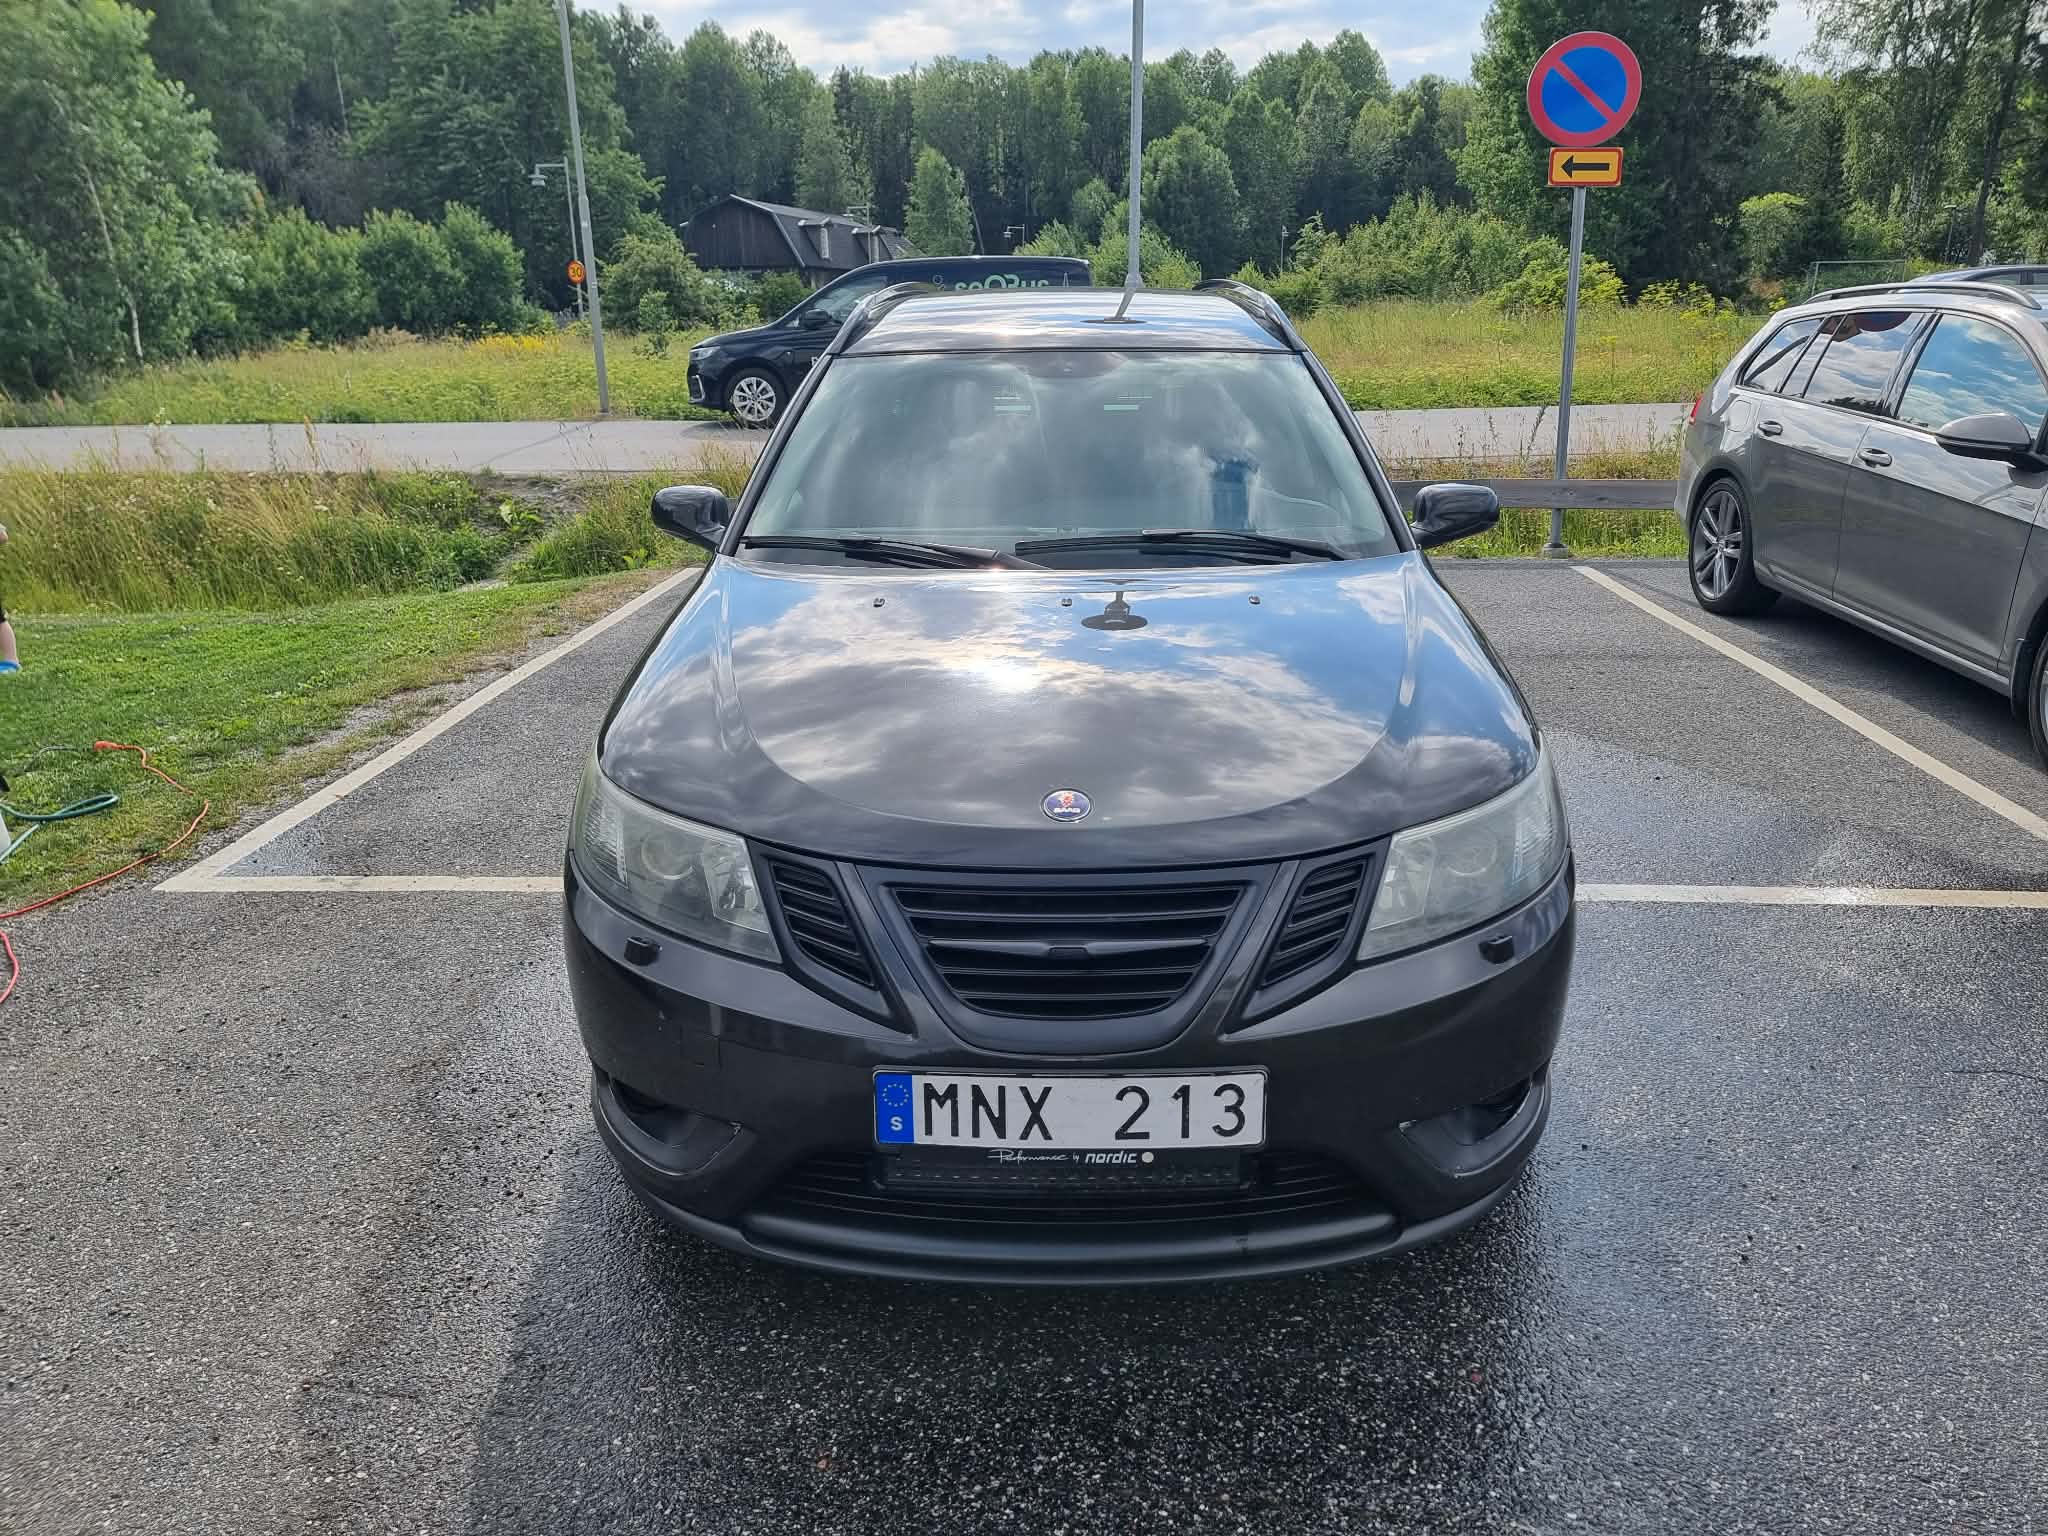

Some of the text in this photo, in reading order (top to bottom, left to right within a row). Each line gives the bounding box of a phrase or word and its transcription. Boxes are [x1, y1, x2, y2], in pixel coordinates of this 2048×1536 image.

[923, 1083, 1246, 1140] MNX 213
[889, 1116, 903, 1132] S
[1085, 1150, 1138, 1165] nordic
